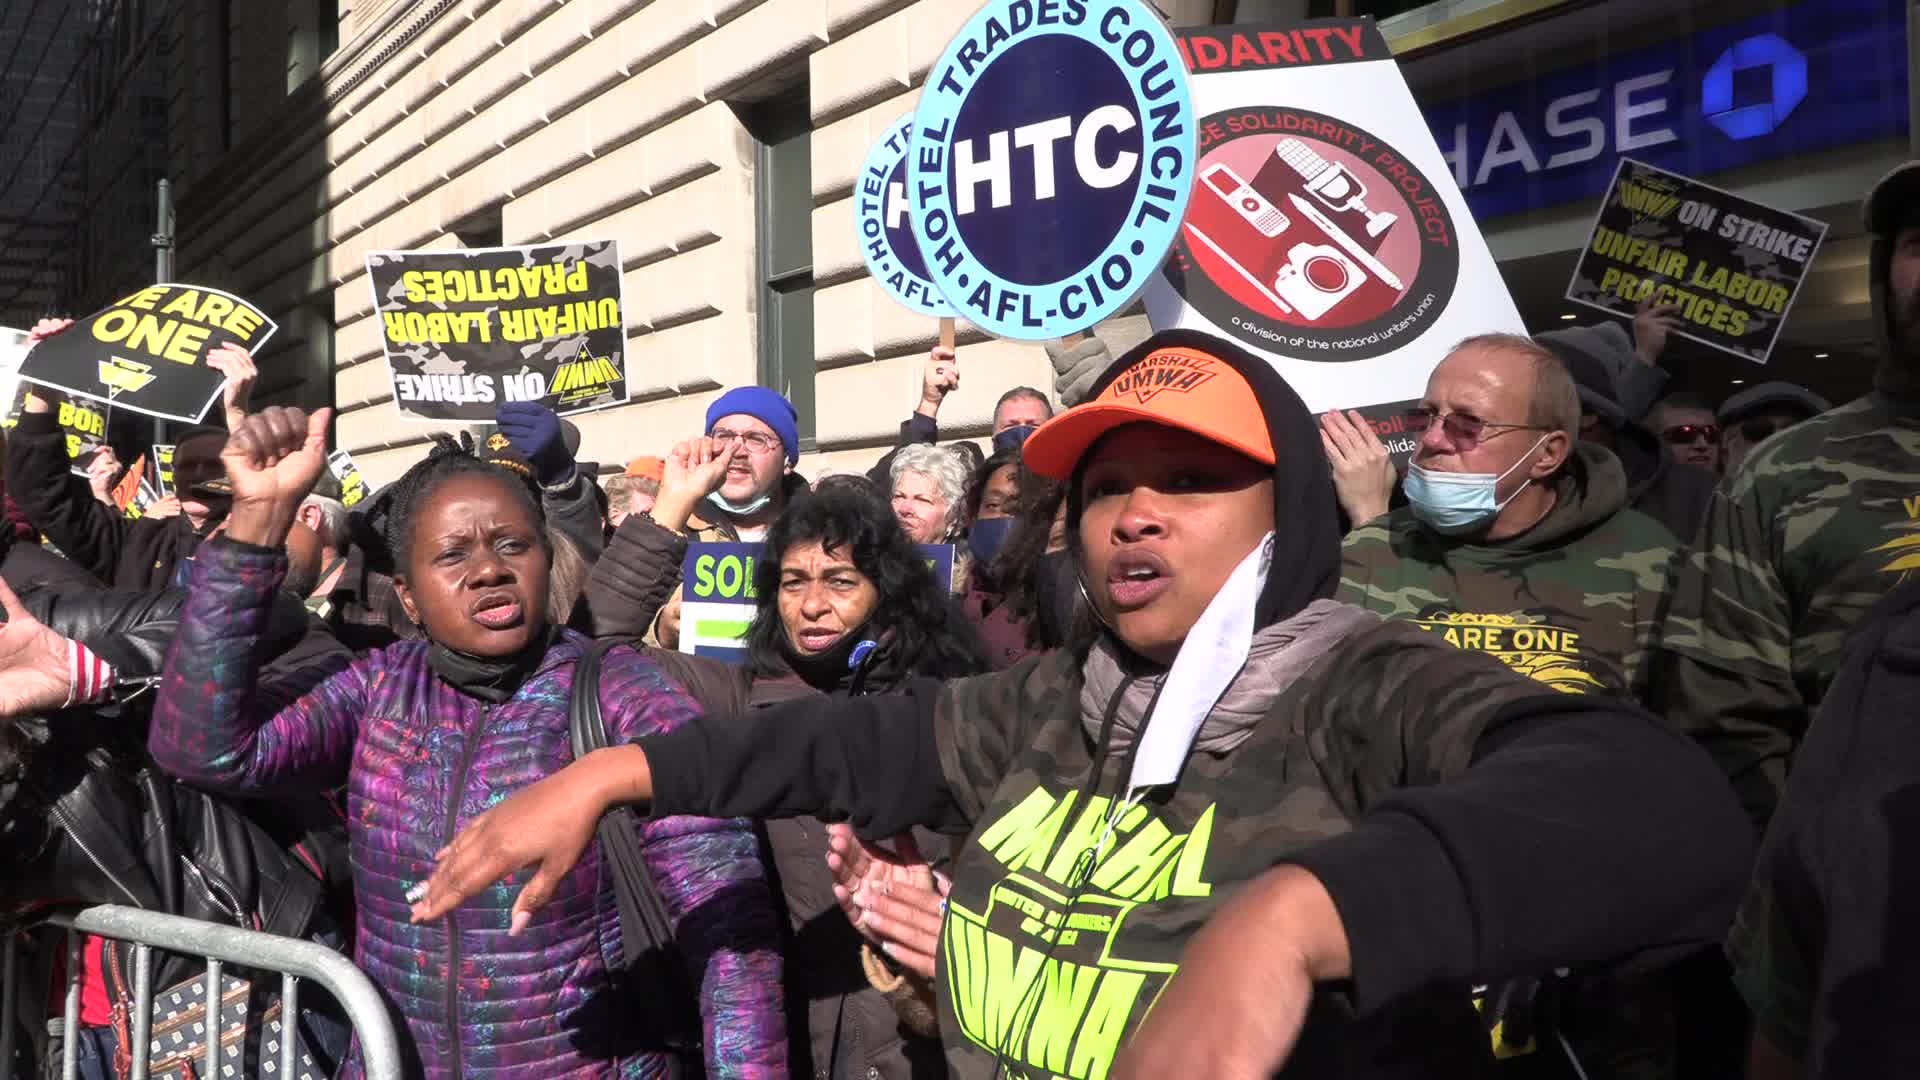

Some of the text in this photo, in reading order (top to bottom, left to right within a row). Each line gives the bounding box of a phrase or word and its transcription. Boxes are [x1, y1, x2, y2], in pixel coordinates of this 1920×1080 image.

[918, 0, 1184, 278] HOTEL TRADES COUNCIL
[954, 104, 1139, 216] HTC
[1225, 112, 1376, 153] SOLIDARITY
[1376, 151, 1449, 247] PROJECT
[862, 164, 889, 262] HOTEL
[1678, 200, 1718, 231] ON
[1718, 213, 1814, 263] STRIKE
[402, 260, 589, 303] PRACTICES
[967, 253, 1133, 327] AFL-CIO
[1592, 225, 1790, 314] UNFAIR LABOR
[160, 290, 265, 341] ARE
[383, 297, 618, 344] UNFAIR LABOR
[1231, 292, 1436, 351] a division of the national writers union
[1600, 267, 1751, 337] PRACTICES
[92, 308, 213, 366] ONE
[396, 373, 496, 403] STRIKE
[502, 372, 546, 402] ON
[551, 356, 621, 391] UMWA
[1117, 367, 1206, 393] UMWA
[1443, 627, 1580, 654] ARE ONE
